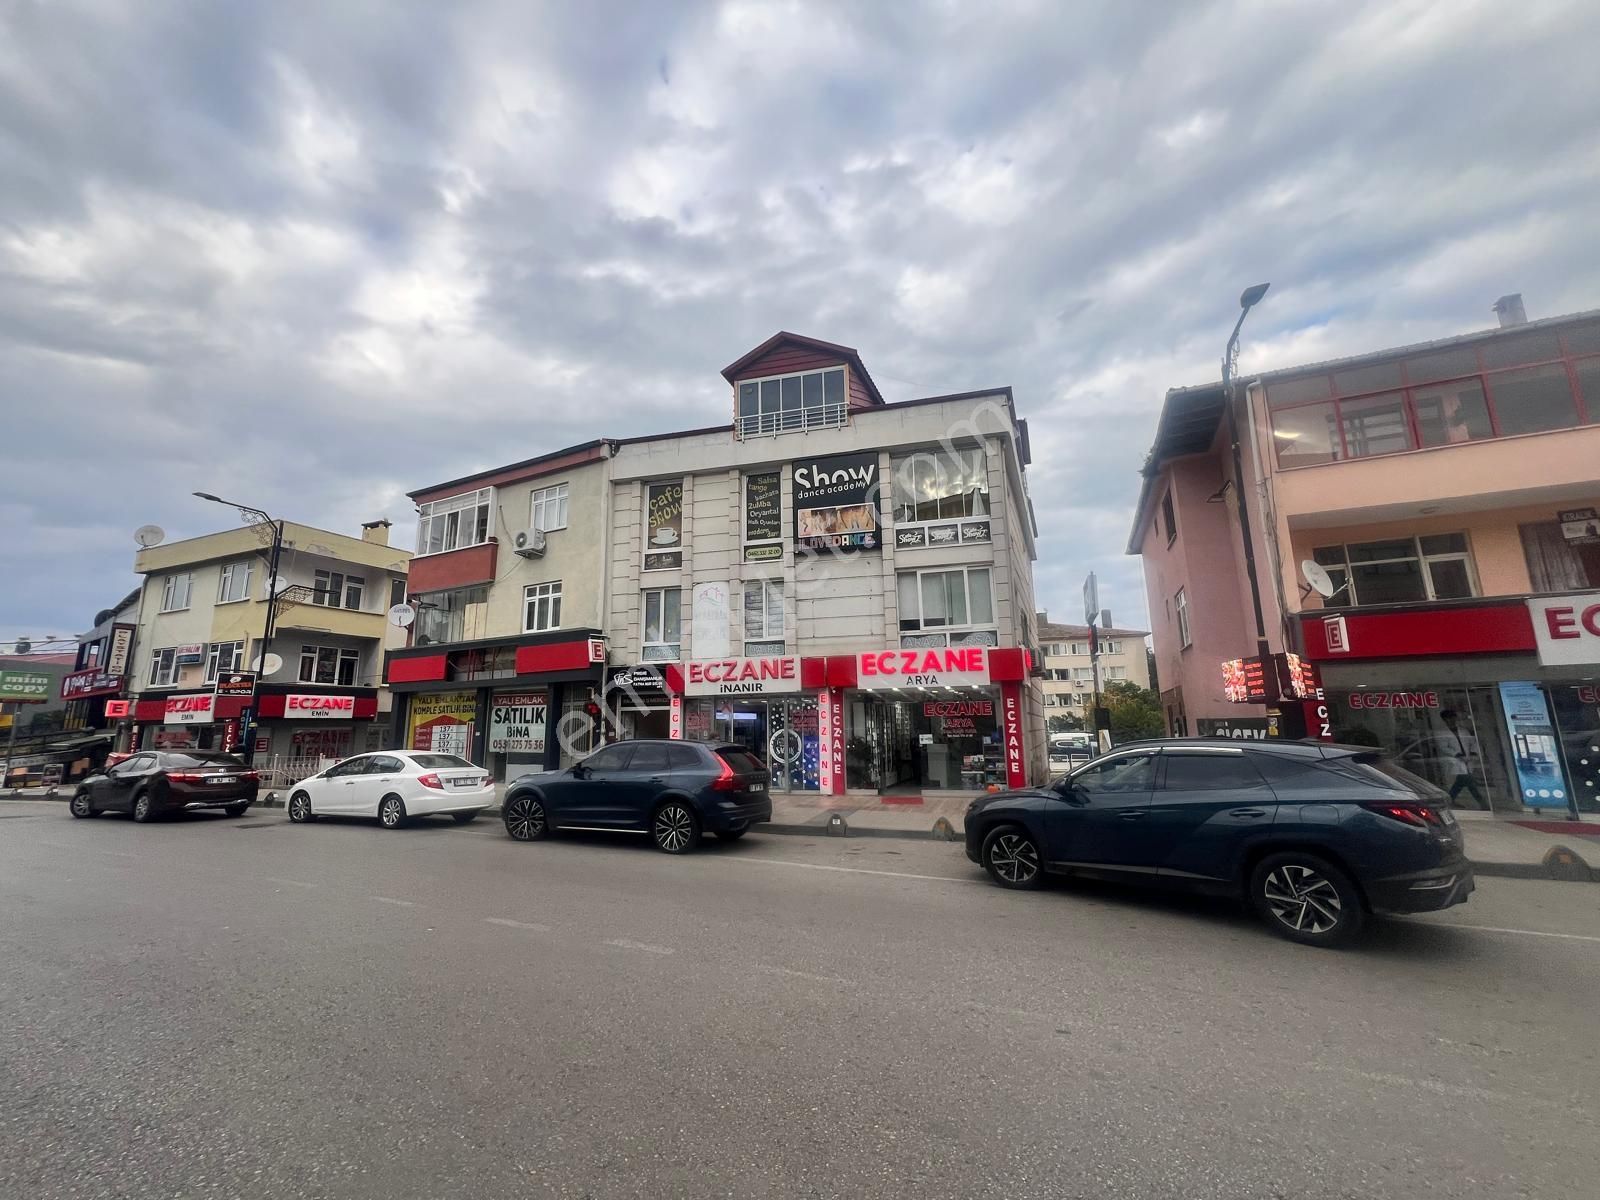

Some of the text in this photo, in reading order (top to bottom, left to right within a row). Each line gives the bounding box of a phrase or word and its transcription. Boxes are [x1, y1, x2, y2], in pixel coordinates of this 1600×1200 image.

[794, 464, 875, 489] Show
[649, 486, 682, 510] cafe
[797, 489, 825, 499] dance
[689, 657, 796, 683] ECZANE
[861, 648, 985, 676] ECZANE
[5, 674, 48, 684] mim
[906, 674, 939, 685] ARYA
[2, 684, 48, 693] copy
[288, 697, 353, 710] ECZANE
[515, 696, 544, 705] EMLAK
[924, 701, 993, 717] ECZANE
[1348, 692, 1440, 709] ECZANE
[494, 707, 546, 724] SATILIK
[820, 694, 829, 786] ECZANE
[832, 703, 842, 774] ECZANE
[1006, 698, 1020, 773] ECZANE
[534, 739, 544, 750] 36
